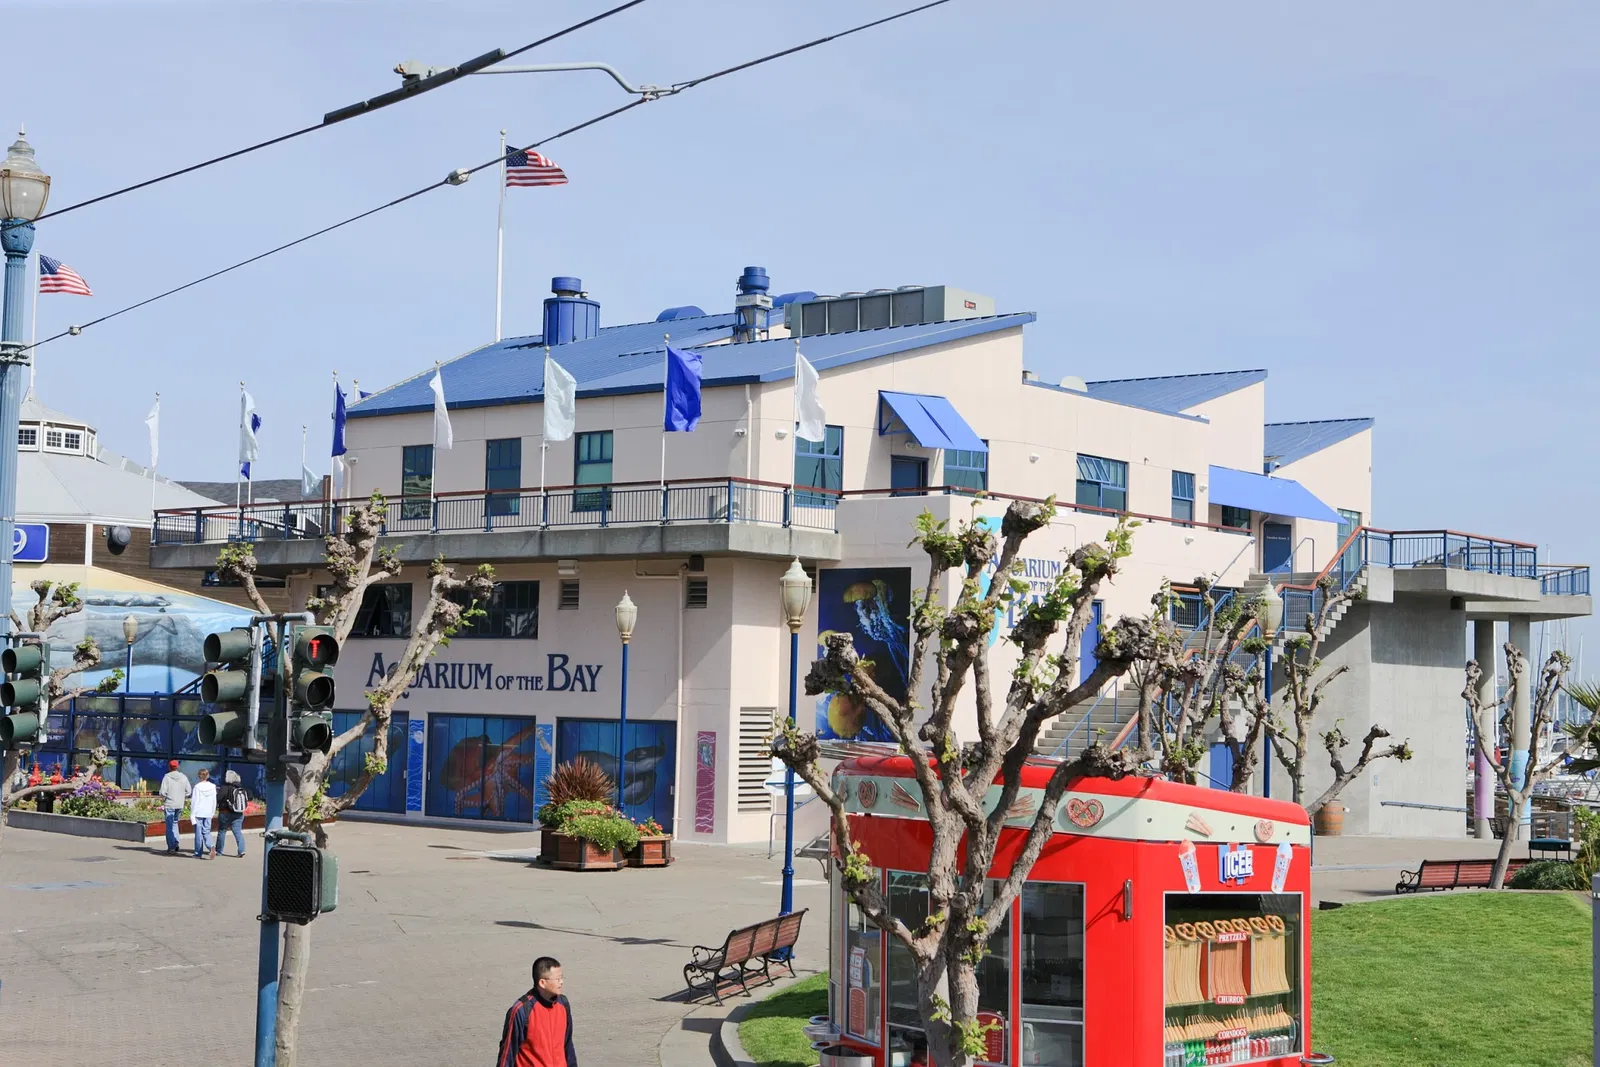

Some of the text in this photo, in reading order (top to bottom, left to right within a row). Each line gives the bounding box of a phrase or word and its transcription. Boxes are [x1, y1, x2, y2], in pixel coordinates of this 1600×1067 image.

[495, 675, 514, 690] OF
[516, 675, 544, 691] THE
[546, 653, 603, 692] BAY
[1224, 849, 1254, 879] ICEE
[1218, 932, 1248, 942] PRETZELS
[1217, 995, 1245, 1004] CHURROS
